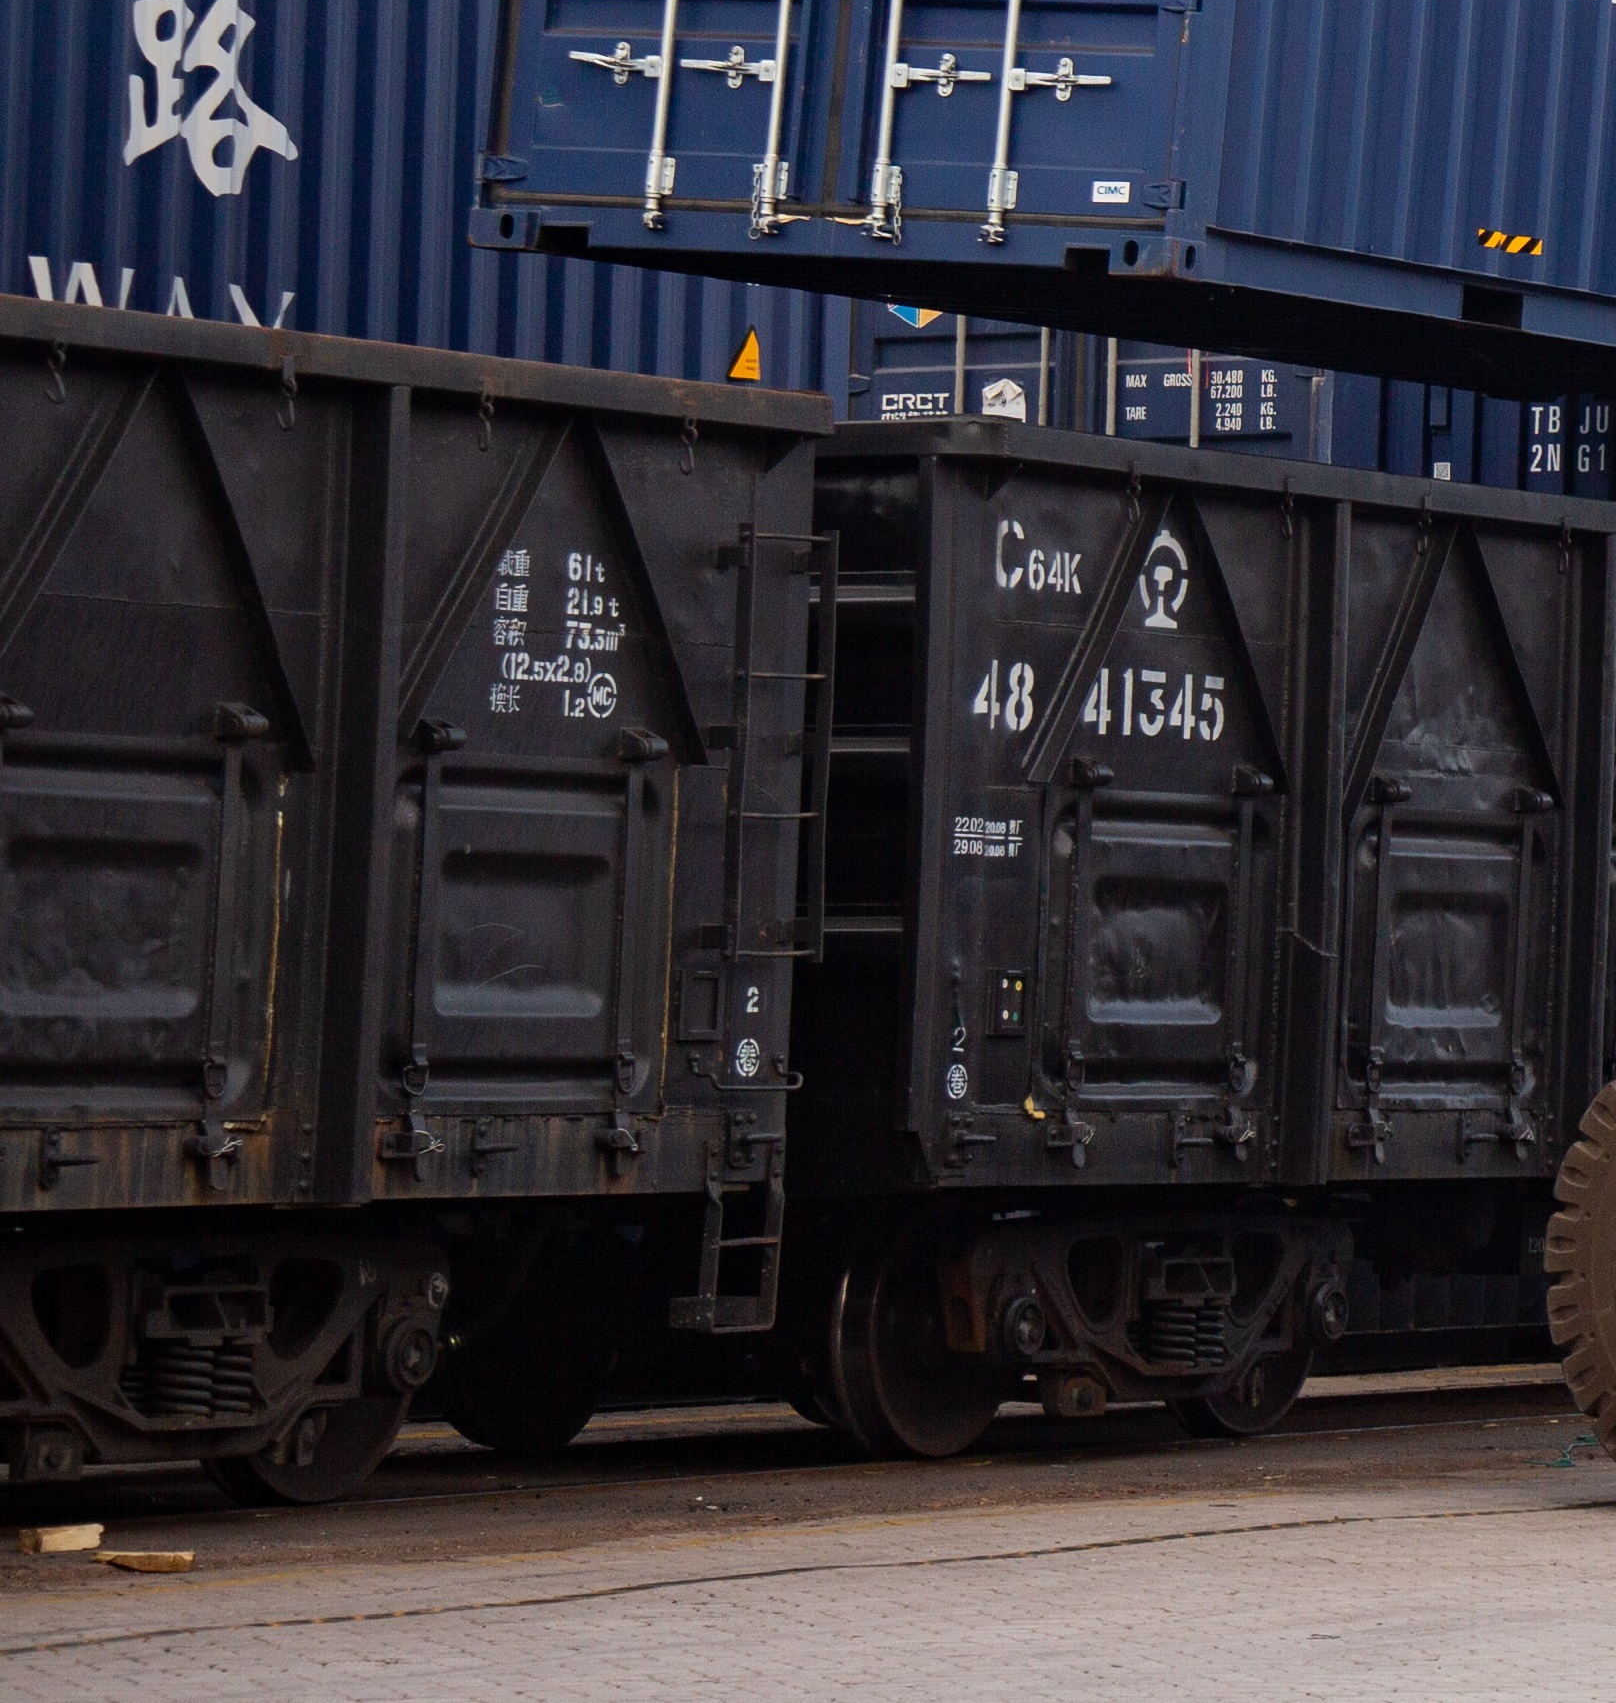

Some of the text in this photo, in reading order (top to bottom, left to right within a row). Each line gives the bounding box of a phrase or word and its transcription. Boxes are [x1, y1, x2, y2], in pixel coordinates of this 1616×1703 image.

[1096, 184, 1127, 196] CIMC
[1125, 374, 1147, 389] MAX
[1163, 373, 1193, 388] GROSS
[1210, 370, 1243, 385] 30.480
[1210, 384, 1243, 400] 67.200
[881, 393, 949, 410] CRCT
[1125, 406, 1147, 421] TARE
[1215, 402, 1242, 417] 2.240
[1215, 417, 1242, 432] 4.940
[1531, 406, 1610, 435] TBJU
[1530, 443, 1606, 473] 2NG1
[995, 519, 1083, 595] C64K
[495, 582, 530, 612] 自重
[564, 689, 586, 718] 1.2
[973, 659, 1225, 741] 48 41345
[746, 986, 759, 1013] 2
[953, 1026, 966, 1052] 2
